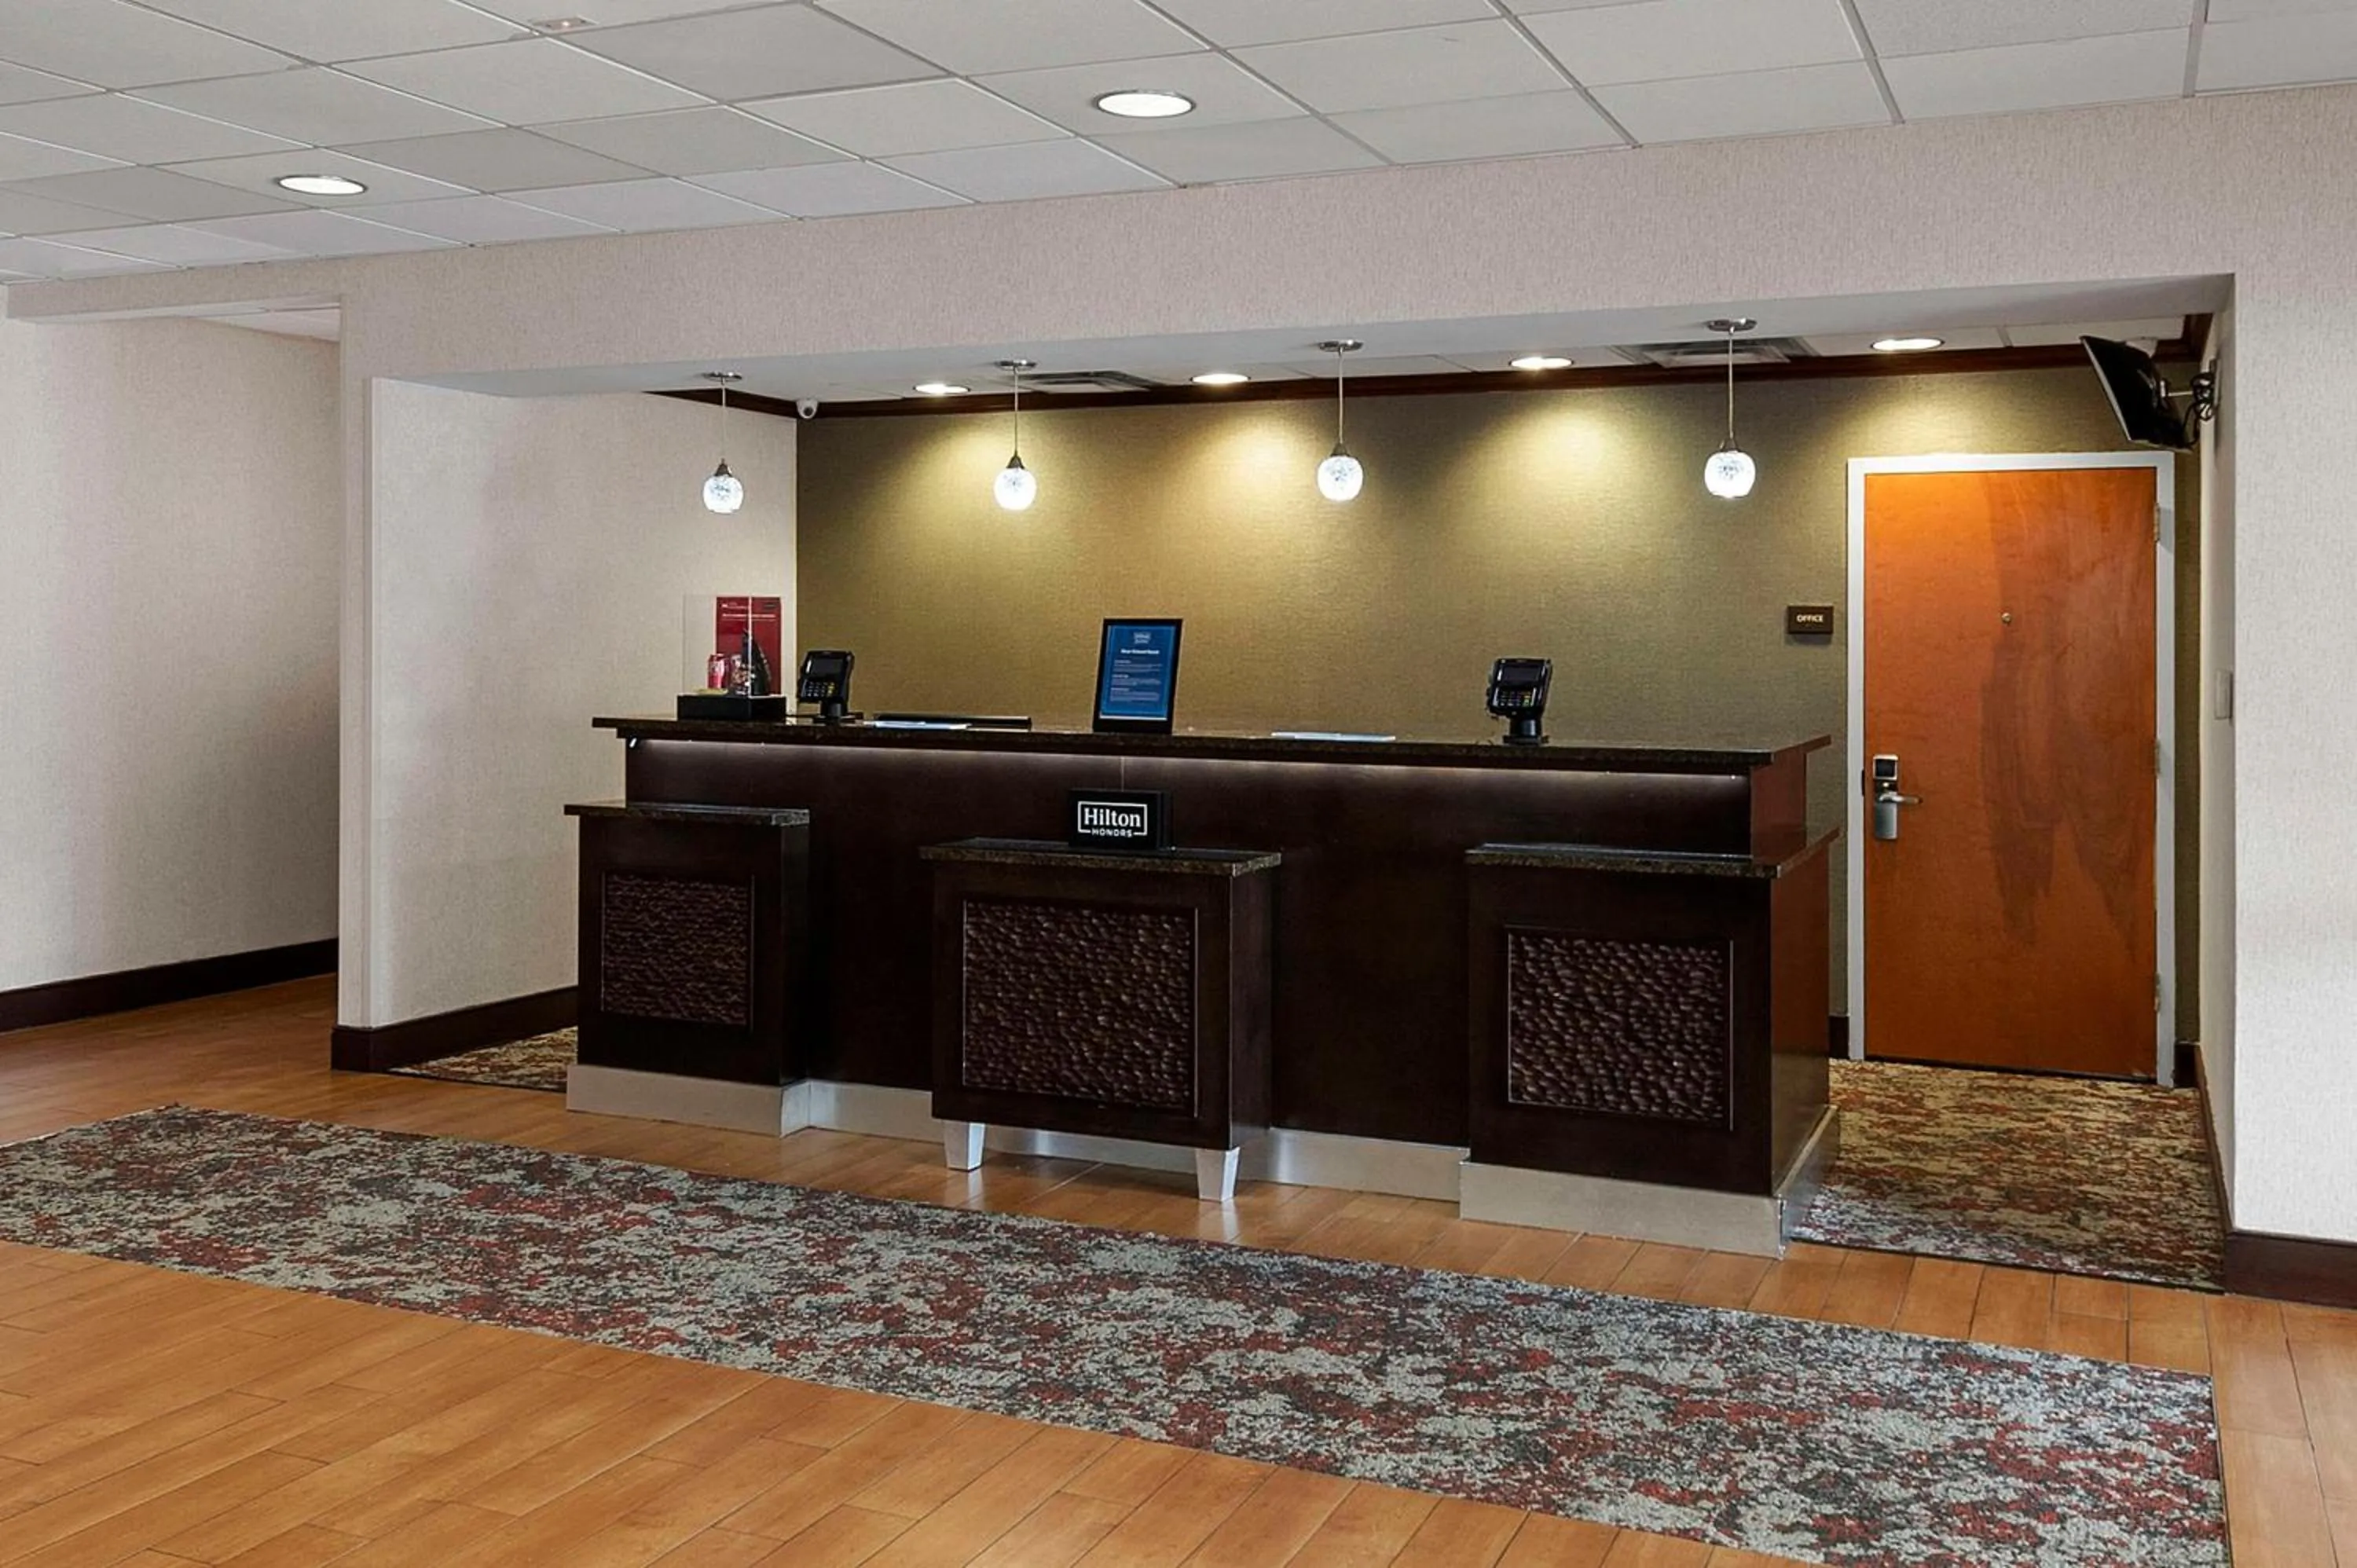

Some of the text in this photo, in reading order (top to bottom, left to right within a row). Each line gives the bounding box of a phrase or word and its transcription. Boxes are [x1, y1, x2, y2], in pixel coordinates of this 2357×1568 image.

[1797, 614, 1824, 623] OFFICE
[1084, 808, 1141, 827] Hilton
[1091, 827, 1132, 837] HONORS
